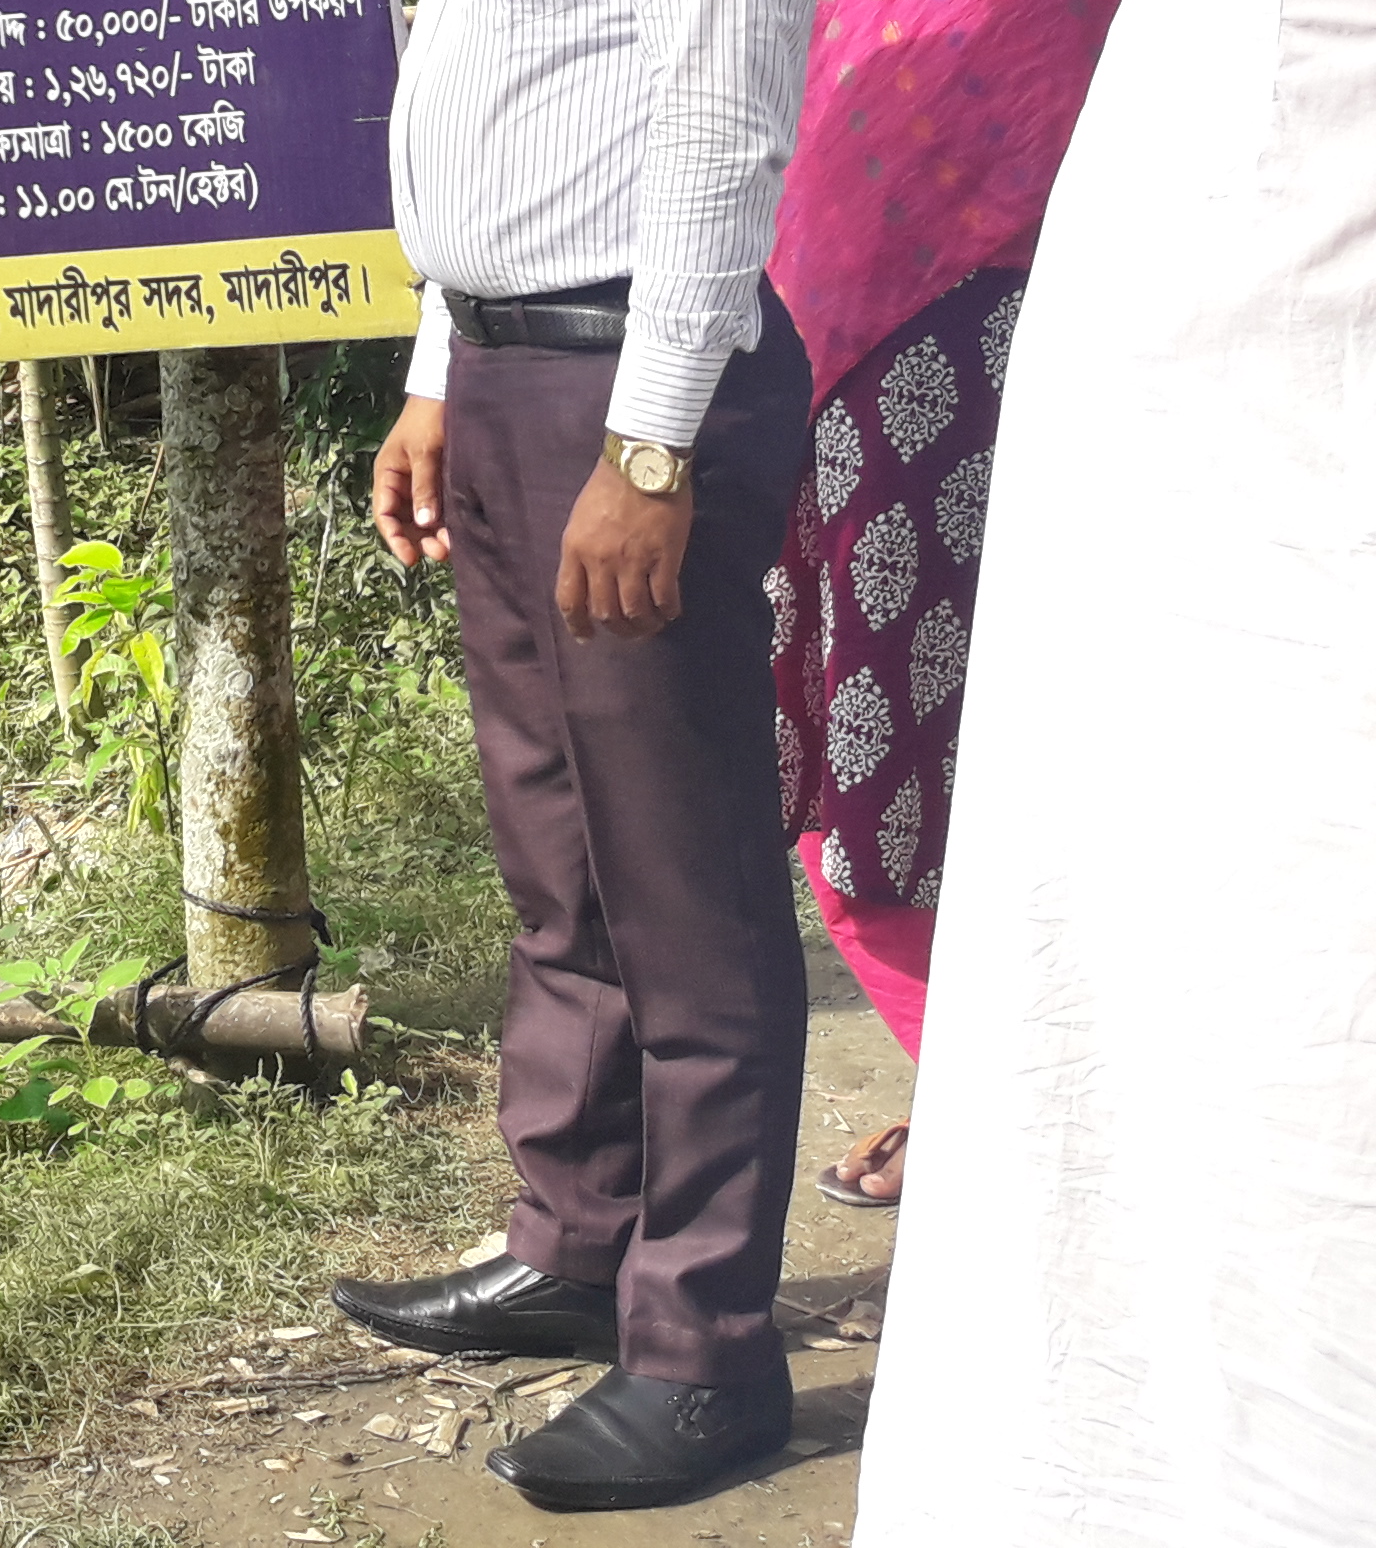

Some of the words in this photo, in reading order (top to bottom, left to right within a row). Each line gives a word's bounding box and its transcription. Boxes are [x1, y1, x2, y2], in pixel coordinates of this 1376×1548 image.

[44, 48, 194, 108] ১,২৬,৭২০/-
[196, 42, 257, 89] টাকা
[99, 117, 174, 156] ১৫০০
[177, 98, 247, 148] কেজি
[14, 181, 96, 220] ১১.০০
[103, 159, 261, 215] মে.টন/হেক্টর)
[2, 263, 132, 334] মাদারীপুর
[137, 270, 216, 326] সদর,
[220, 248, 352, 315] মাদারীপুর
